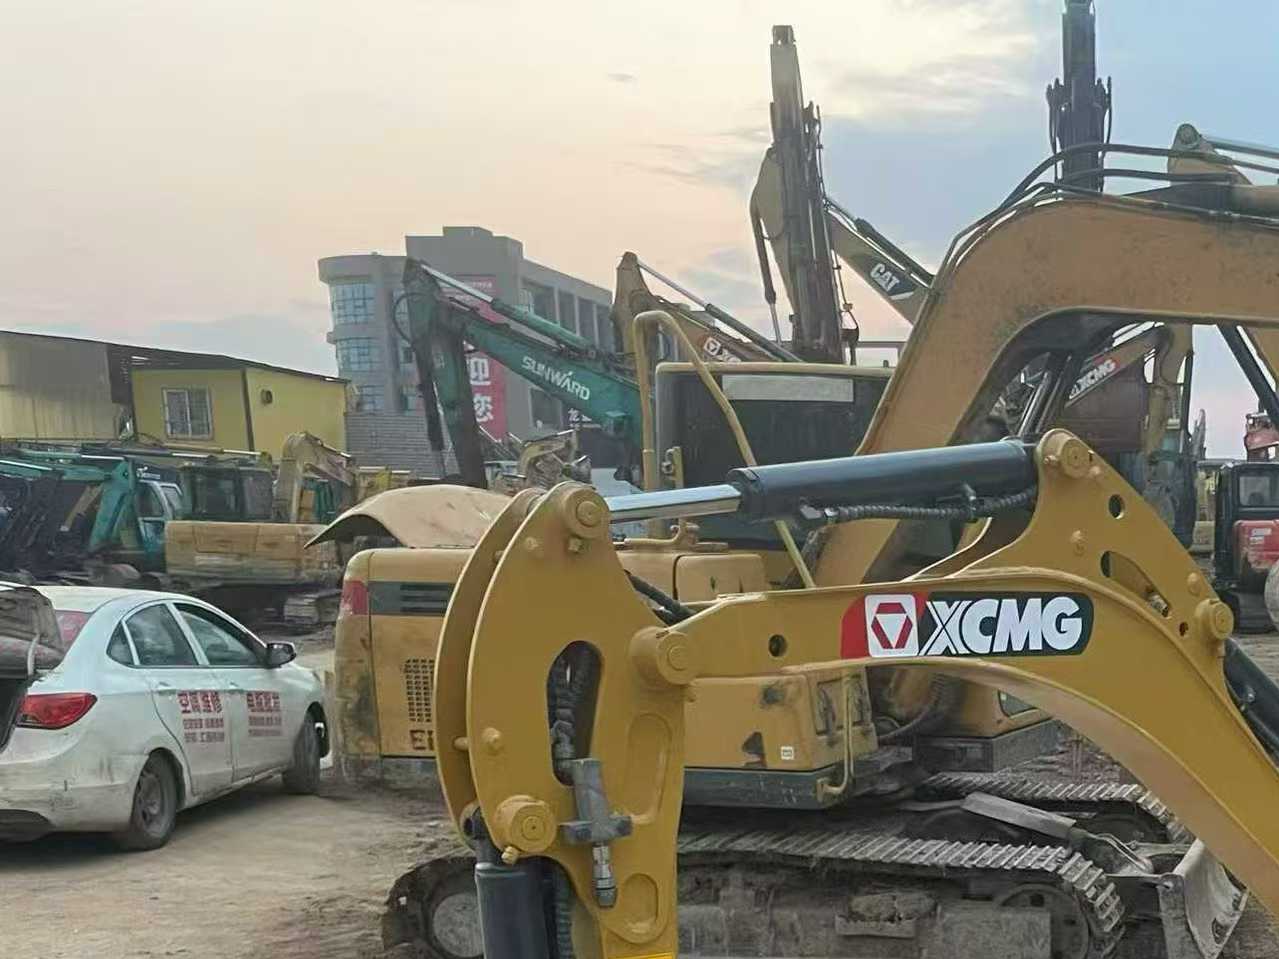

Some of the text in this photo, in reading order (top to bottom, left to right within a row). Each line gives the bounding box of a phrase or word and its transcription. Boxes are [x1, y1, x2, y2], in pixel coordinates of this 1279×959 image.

[870, 262, 900, 292] CAT
[520, 355, 591, 401] SUNWARD
[917, 596, 1083, 657] XCMG
